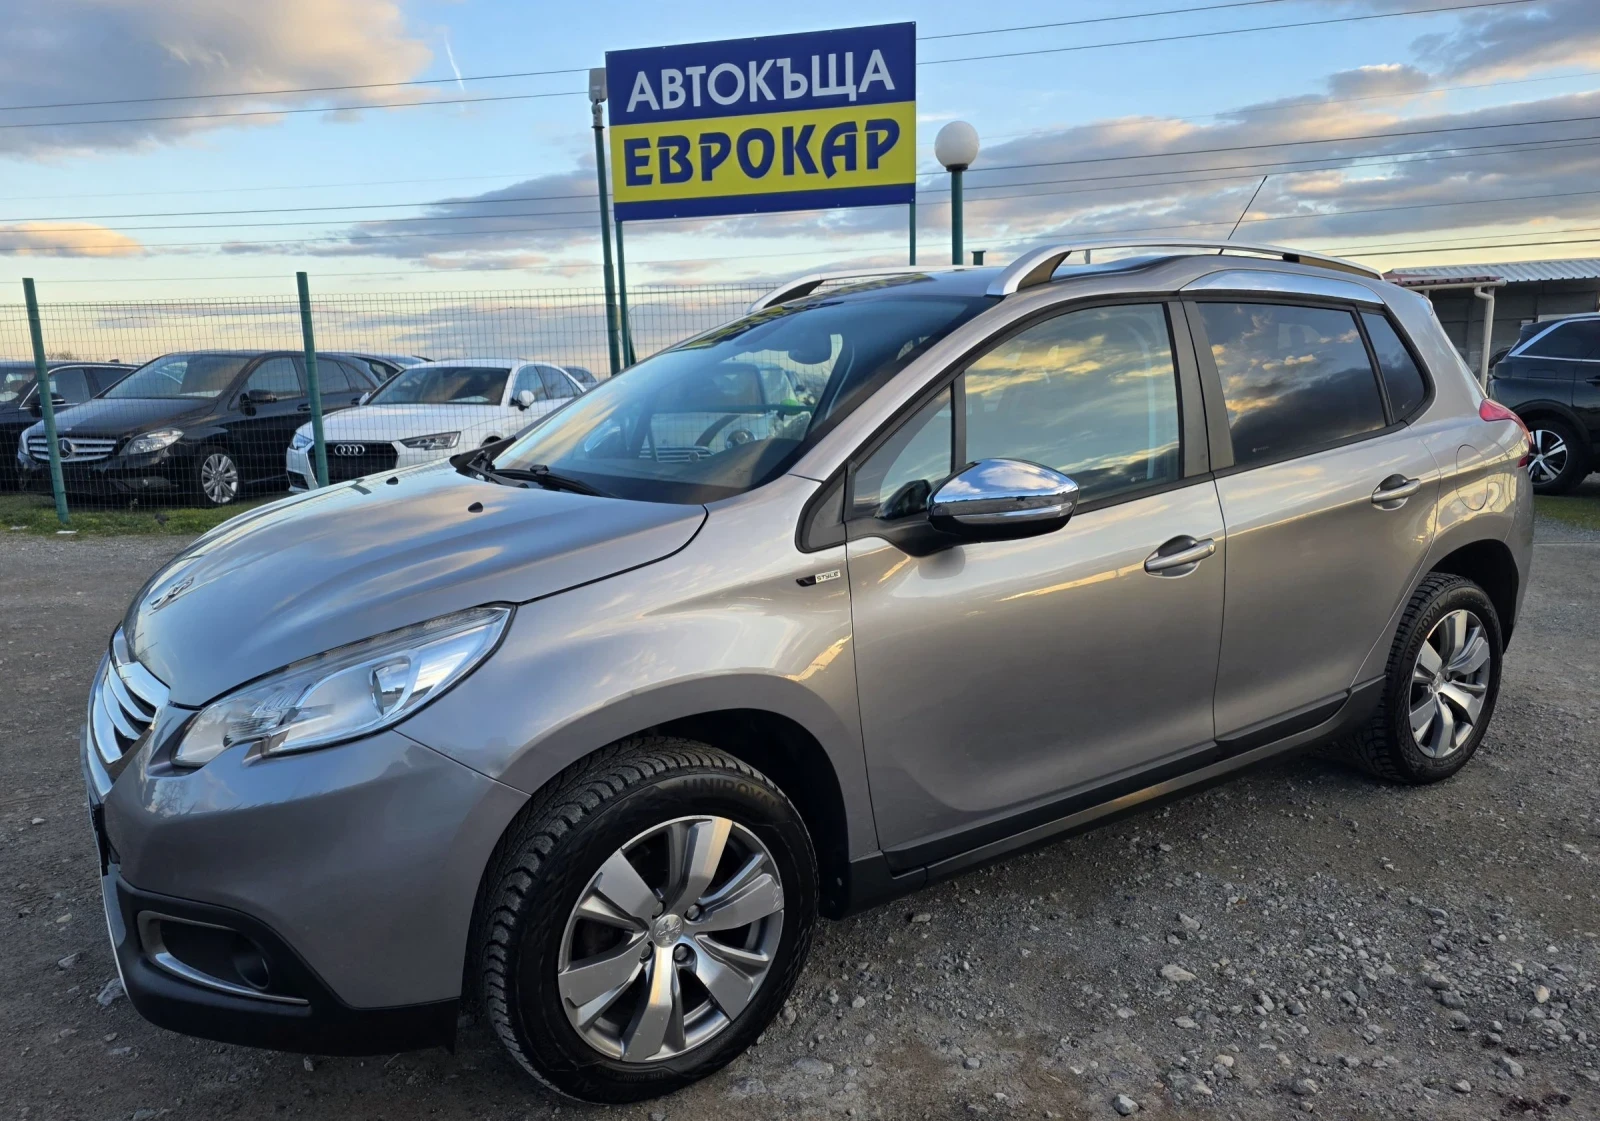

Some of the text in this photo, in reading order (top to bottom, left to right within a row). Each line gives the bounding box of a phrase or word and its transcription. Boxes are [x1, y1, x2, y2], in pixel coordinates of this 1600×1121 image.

[626, 49, 896, 112] АВТОКЪЩА
[623, 118, 900, 187] ЕВРОКАР
[816, 571, 839, 582] STYLE
[1407, 602, 1442, 660] UNIROYAL
